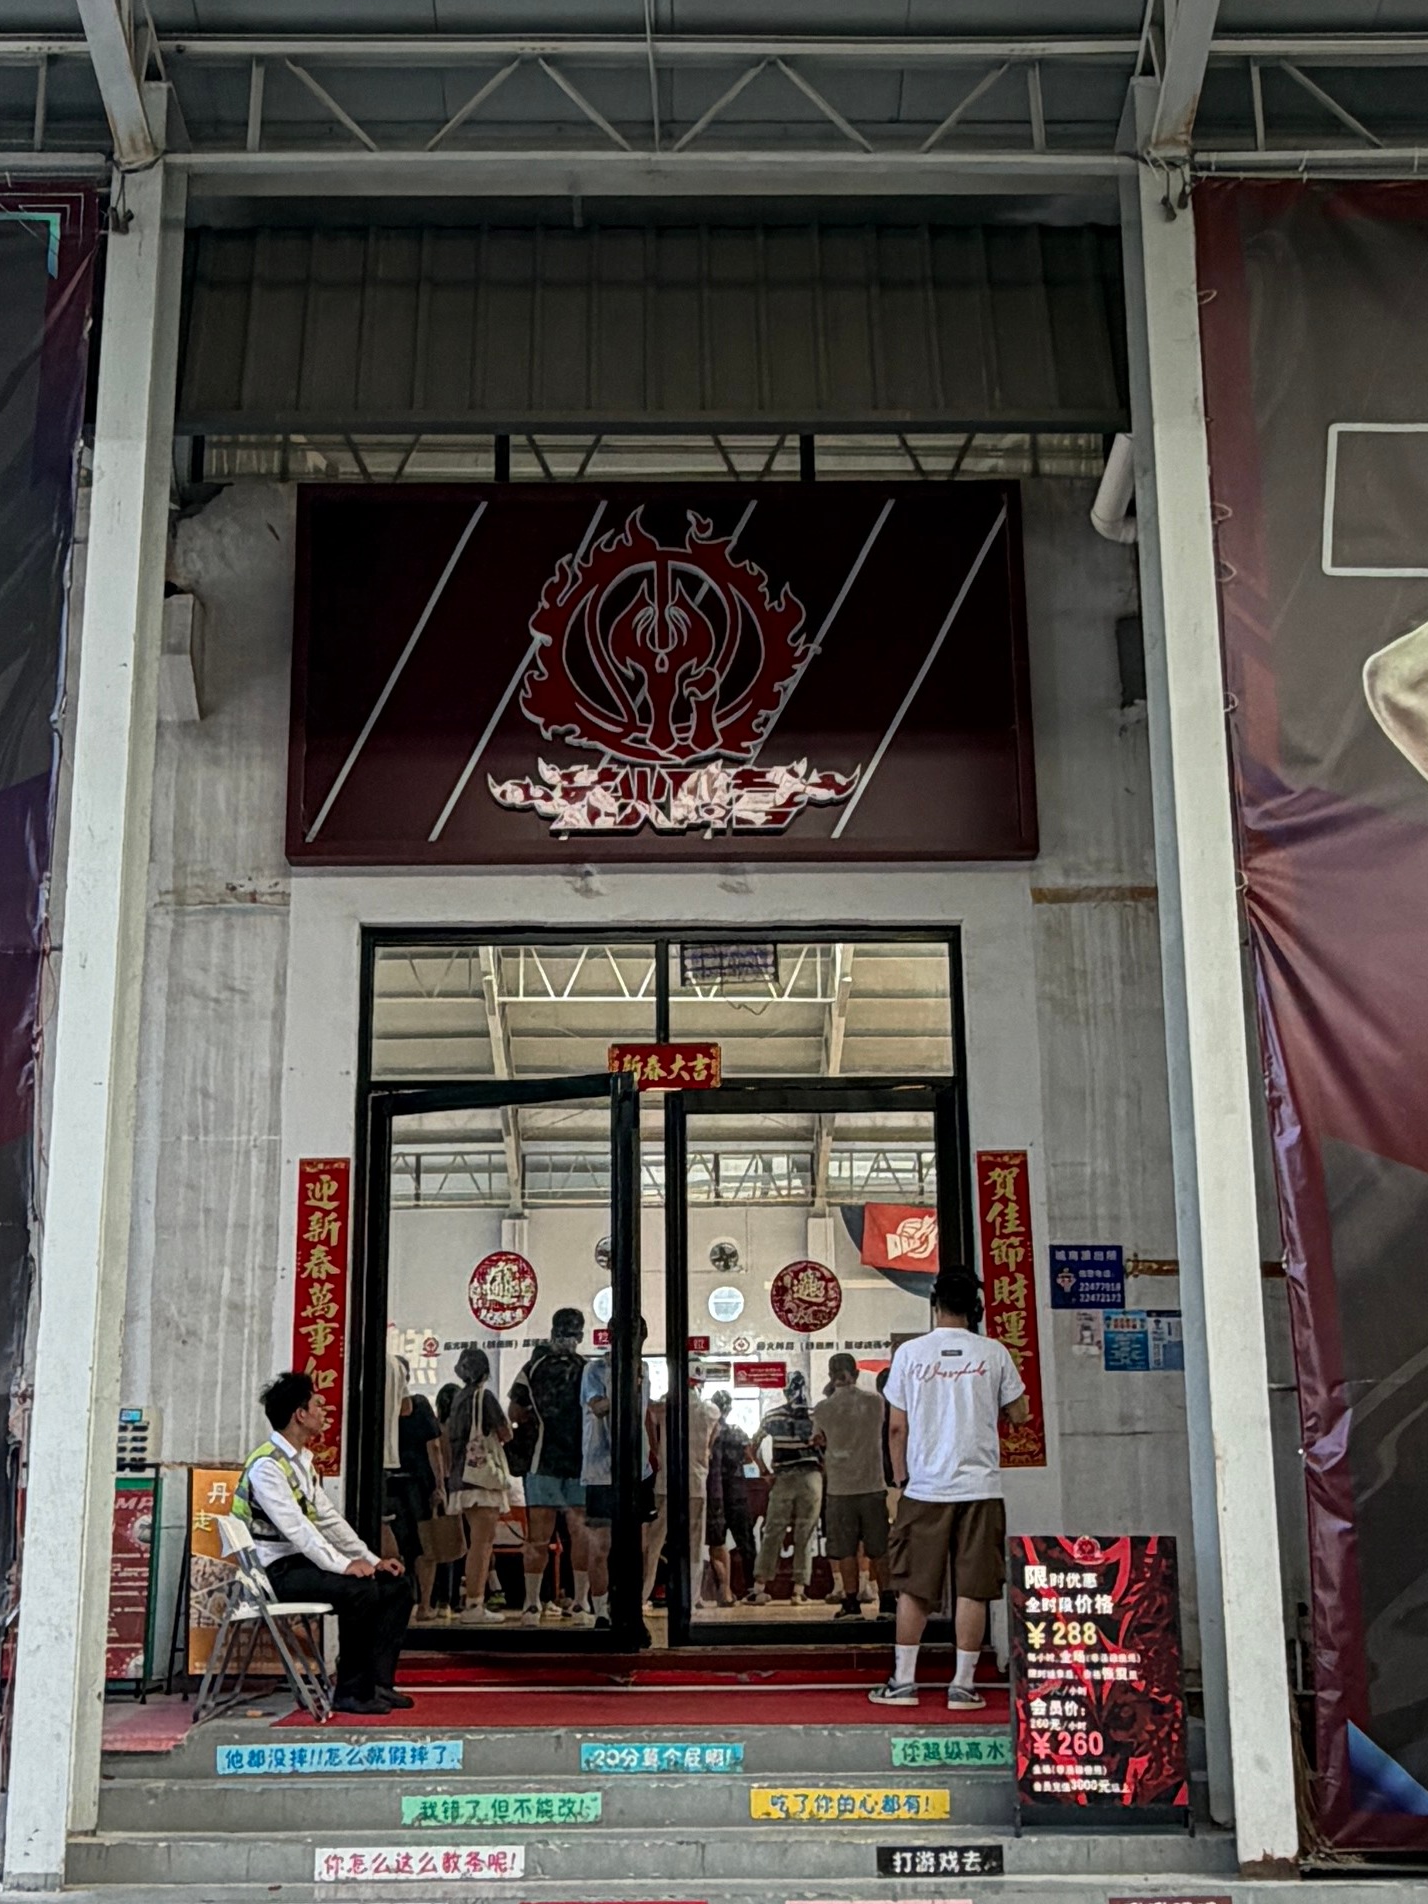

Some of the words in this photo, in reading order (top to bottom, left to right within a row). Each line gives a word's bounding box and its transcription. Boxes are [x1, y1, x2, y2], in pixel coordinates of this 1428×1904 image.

[622, 1053, 711, 1082] 新春大吉
[299, 1174, 342, 1438] 迎新春萬事如
[983, 1166, 1035, 1424] 賀佳節財運
[1024, 1565, 1098, 1590] 限时优惠
[1025, 1594, 1114, 1615] 全时段价格
